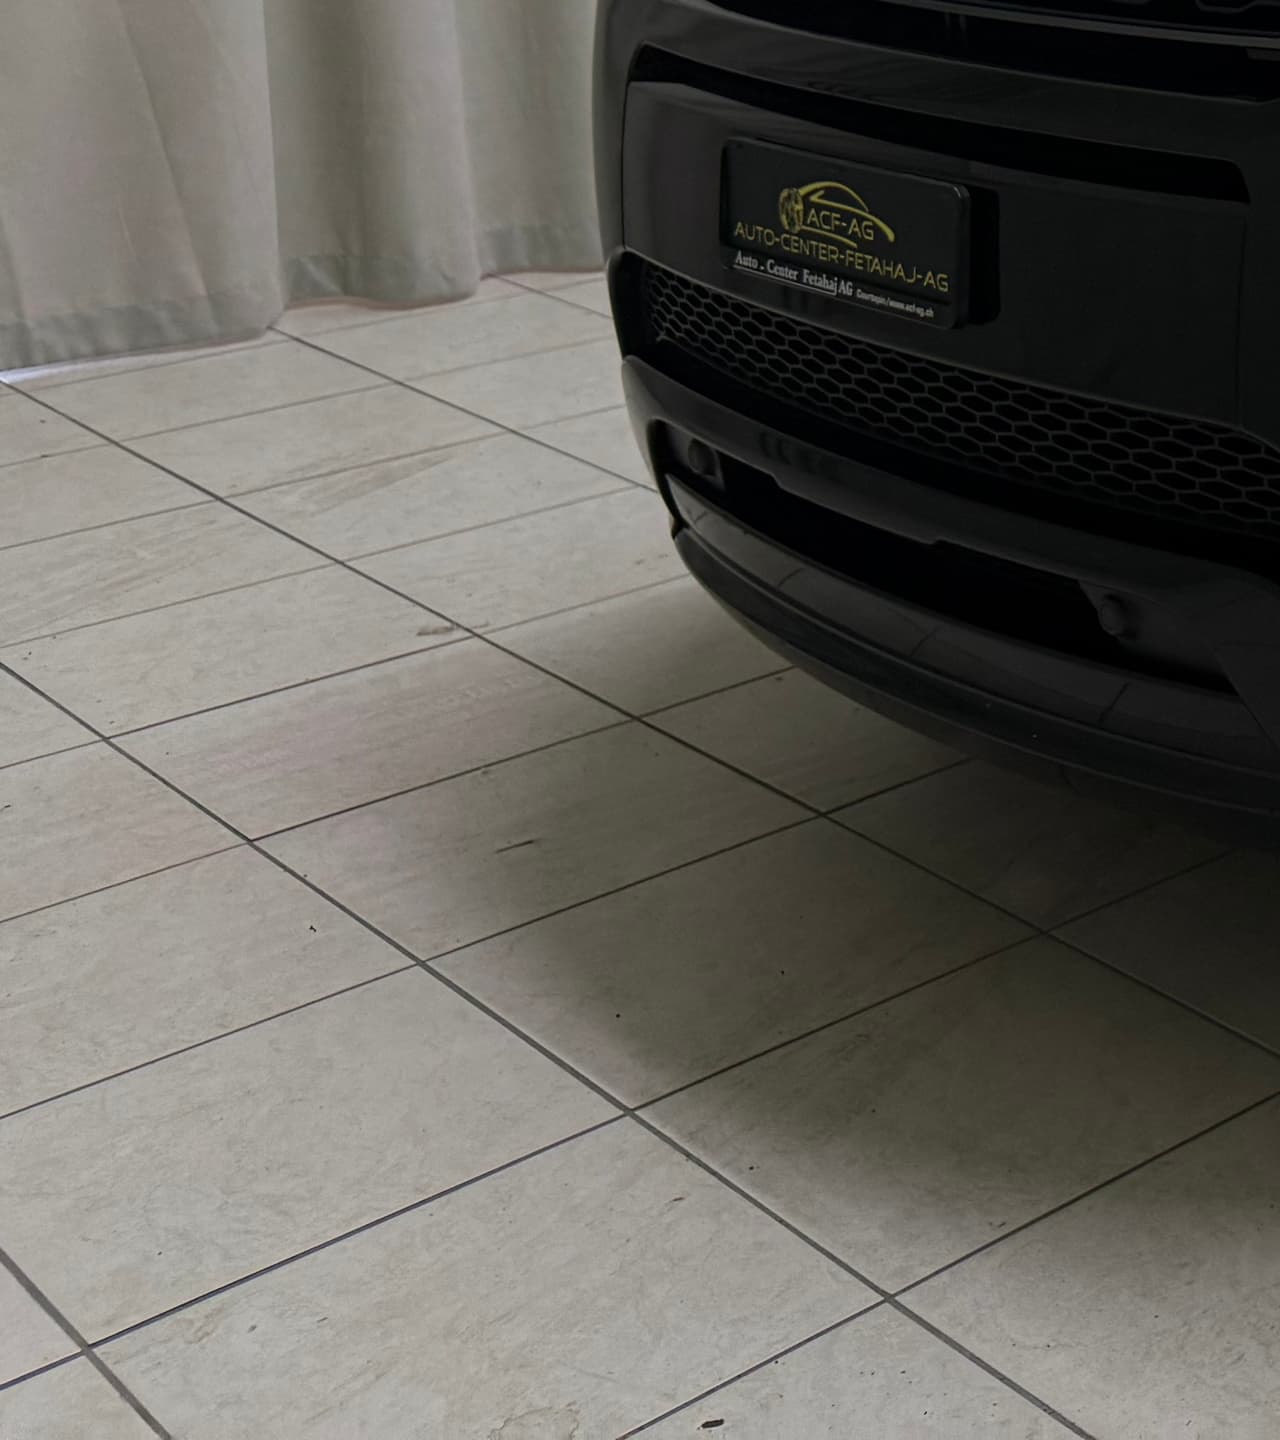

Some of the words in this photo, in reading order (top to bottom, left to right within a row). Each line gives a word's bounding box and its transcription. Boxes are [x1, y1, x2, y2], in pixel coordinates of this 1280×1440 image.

[806, 207, 875, 241] ACF-AG
[734, 221, 950, 293] AUTO-CENTER-FETAHAJ-AG
[735, 249, 759, 269] Auto
[767, 258, 799, 280] Center
[802, 268, 838, 295] Fetahaj
[838, 279, 854, 297] AG
